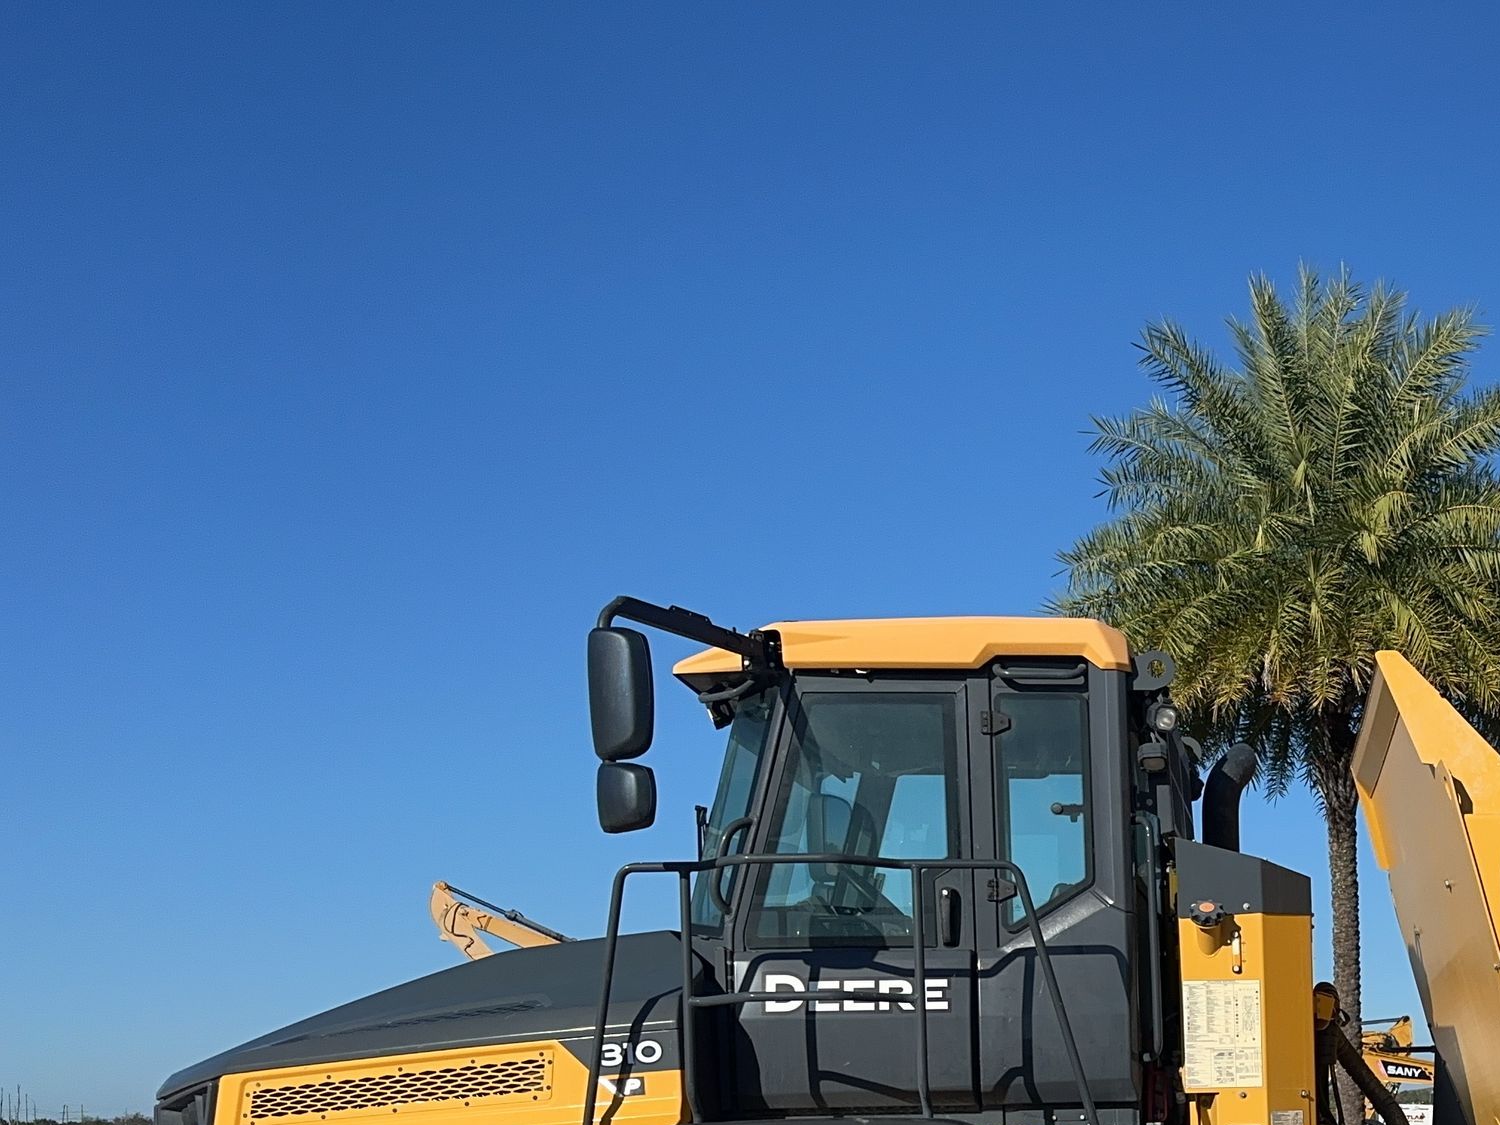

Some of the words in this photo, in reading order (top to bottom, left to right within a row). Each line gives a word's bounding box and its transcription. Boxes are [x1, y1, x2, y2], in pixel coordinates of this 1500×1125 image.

[765, 974, 949, 1013] DEERE
[600, 1040, 663, 1067] 310
[1387, 1065, 1422, 1078] SANY
